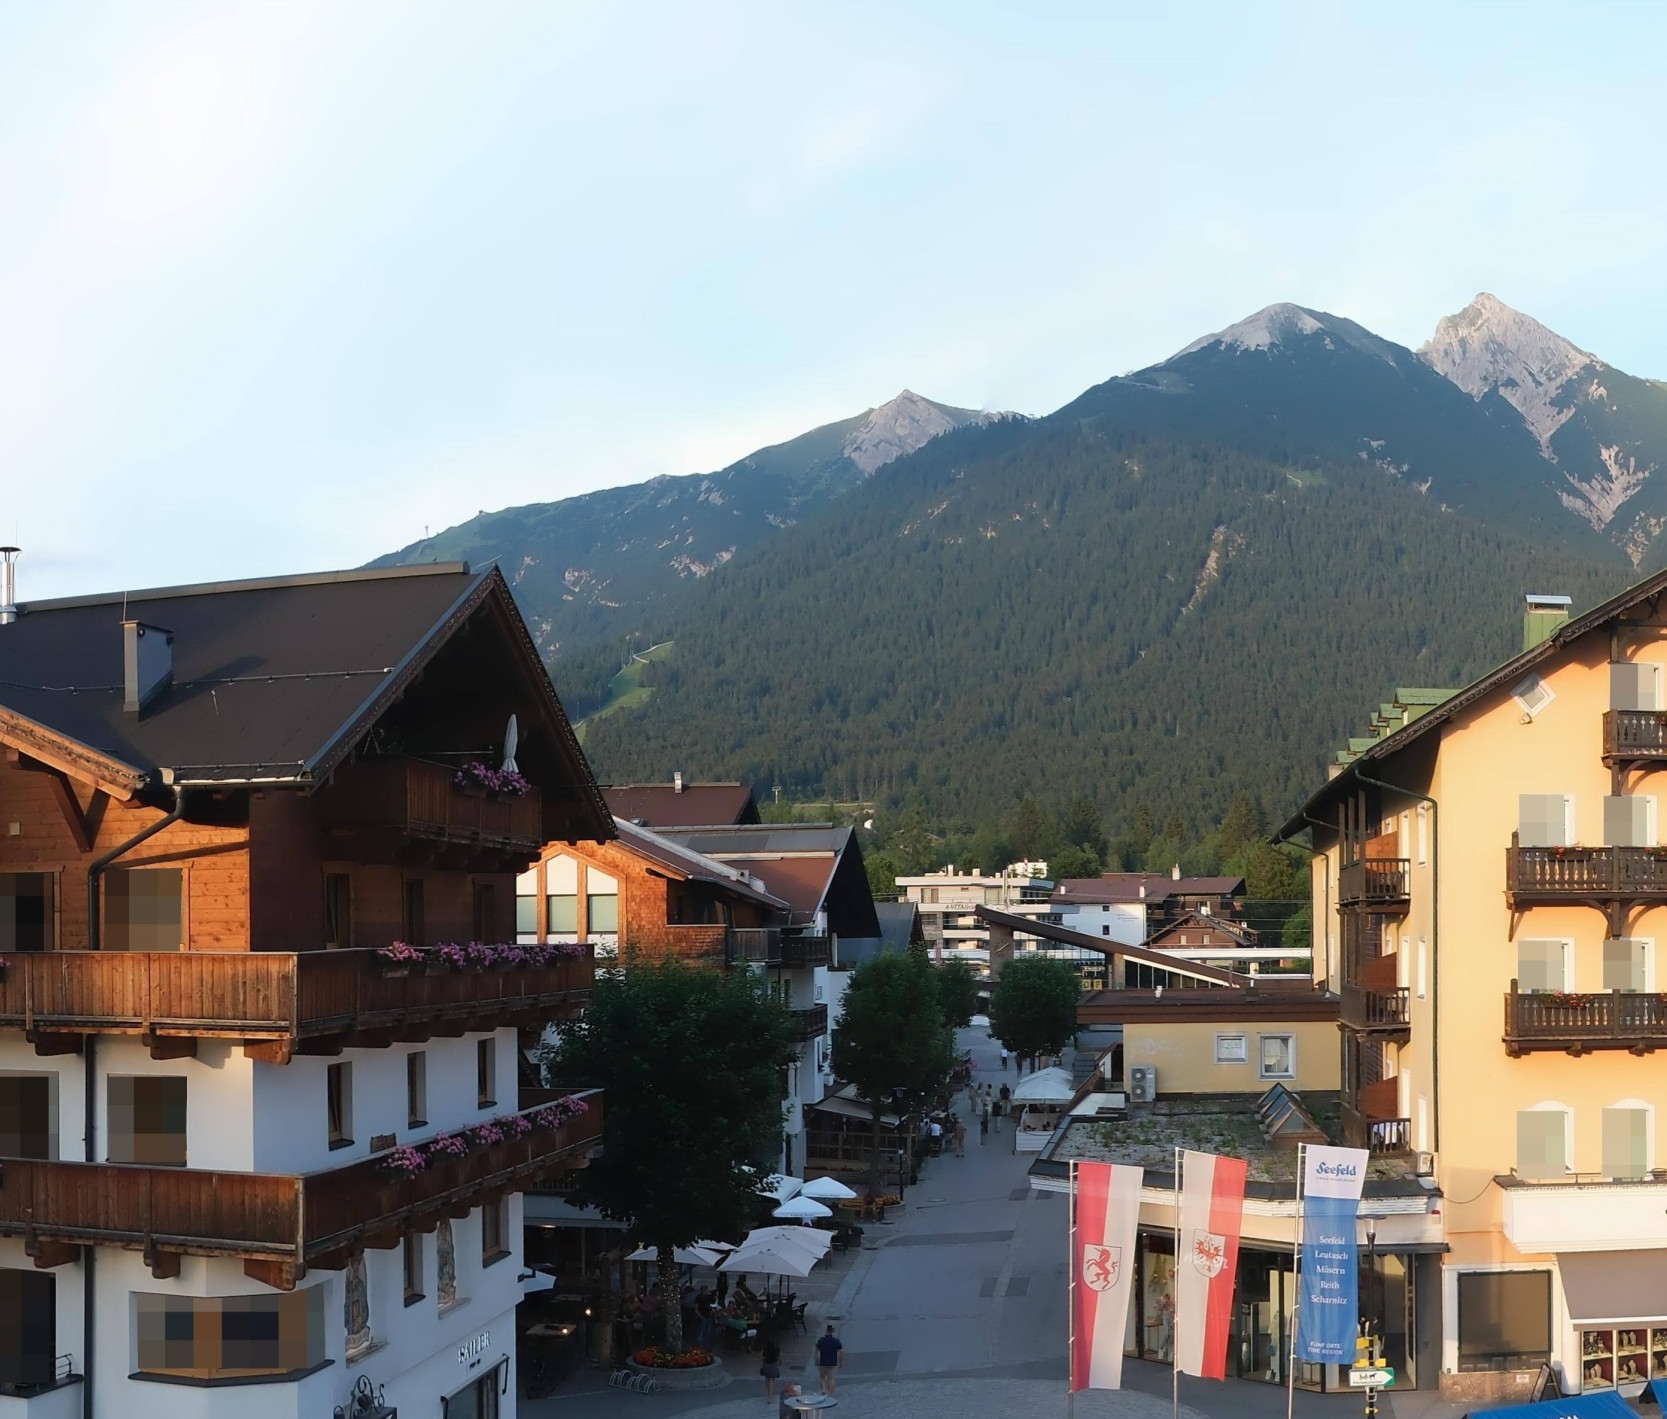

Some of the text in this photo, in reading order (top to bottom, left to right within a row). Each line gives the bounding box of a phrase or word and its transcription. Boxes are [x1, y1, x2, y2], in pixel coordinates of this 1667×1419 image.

[1316, 1161, 1356, 1176] Seefeld
[1319, 1235, 1345, 1245] Seefeld
[1315, 1250, 1348, 1260] Leutasch
[1316, 1265, 1345, 1275] Mösern
[1320, 1280, 1340, 1290] Reith
[1311, 1294, 1347, 1305] Scharnitz
